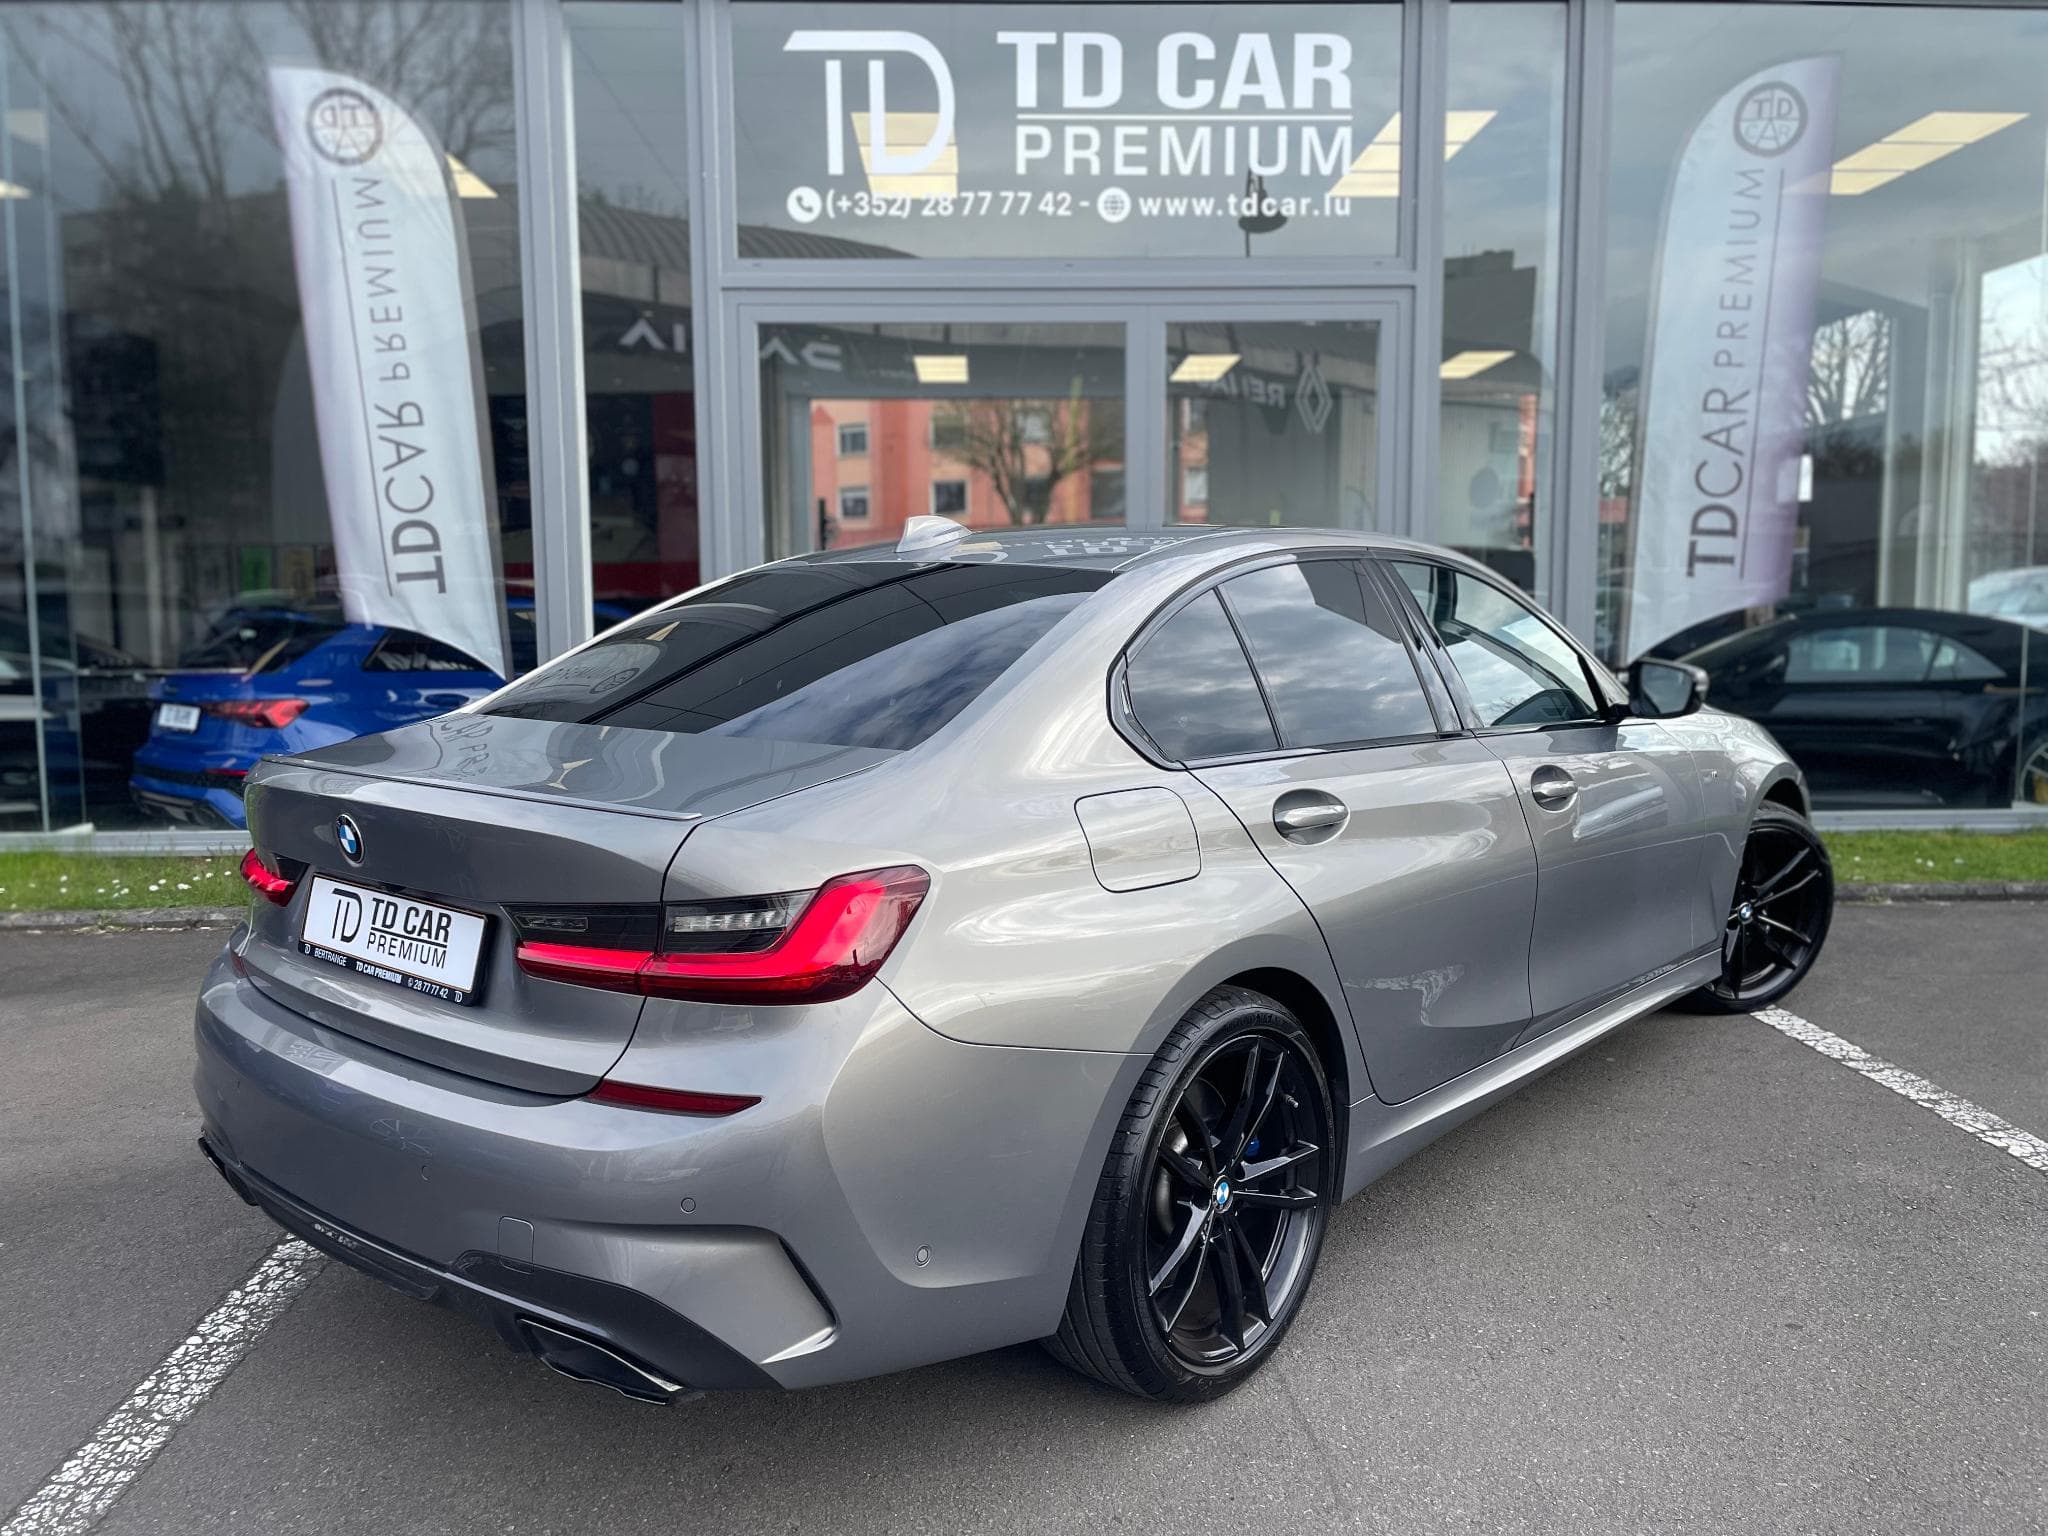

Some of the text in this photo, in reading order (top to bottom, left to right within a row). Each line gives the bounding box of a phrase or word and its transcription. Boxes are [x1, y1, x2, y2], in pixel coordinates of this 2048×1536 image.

[997, 32, 1352, 110] TD CAR
[1016, 126, 1352, 175] PREMIUM
[827, 188, 912, 217] (+352)
[921, 191, 954, 216] 28
[960, 191, 993, 216] 77
[1000, 191, 1033, 216] 77
[1038, 191, 1072, 216] 42
[1139, 188, 1351, 217] www.tdcar.lu
[1713, 168, 1765, 369] PREMIUM
[371, 898, 452, 943] TD CAR
[314, 948, 347, 966] BERTRANGE
[367, 932, 447, 969] PREMIUM
[374, 967, 402, 984] PREMIUM
[413, 979, 422, 991] 28
[439, 987, 449, 999] 42
